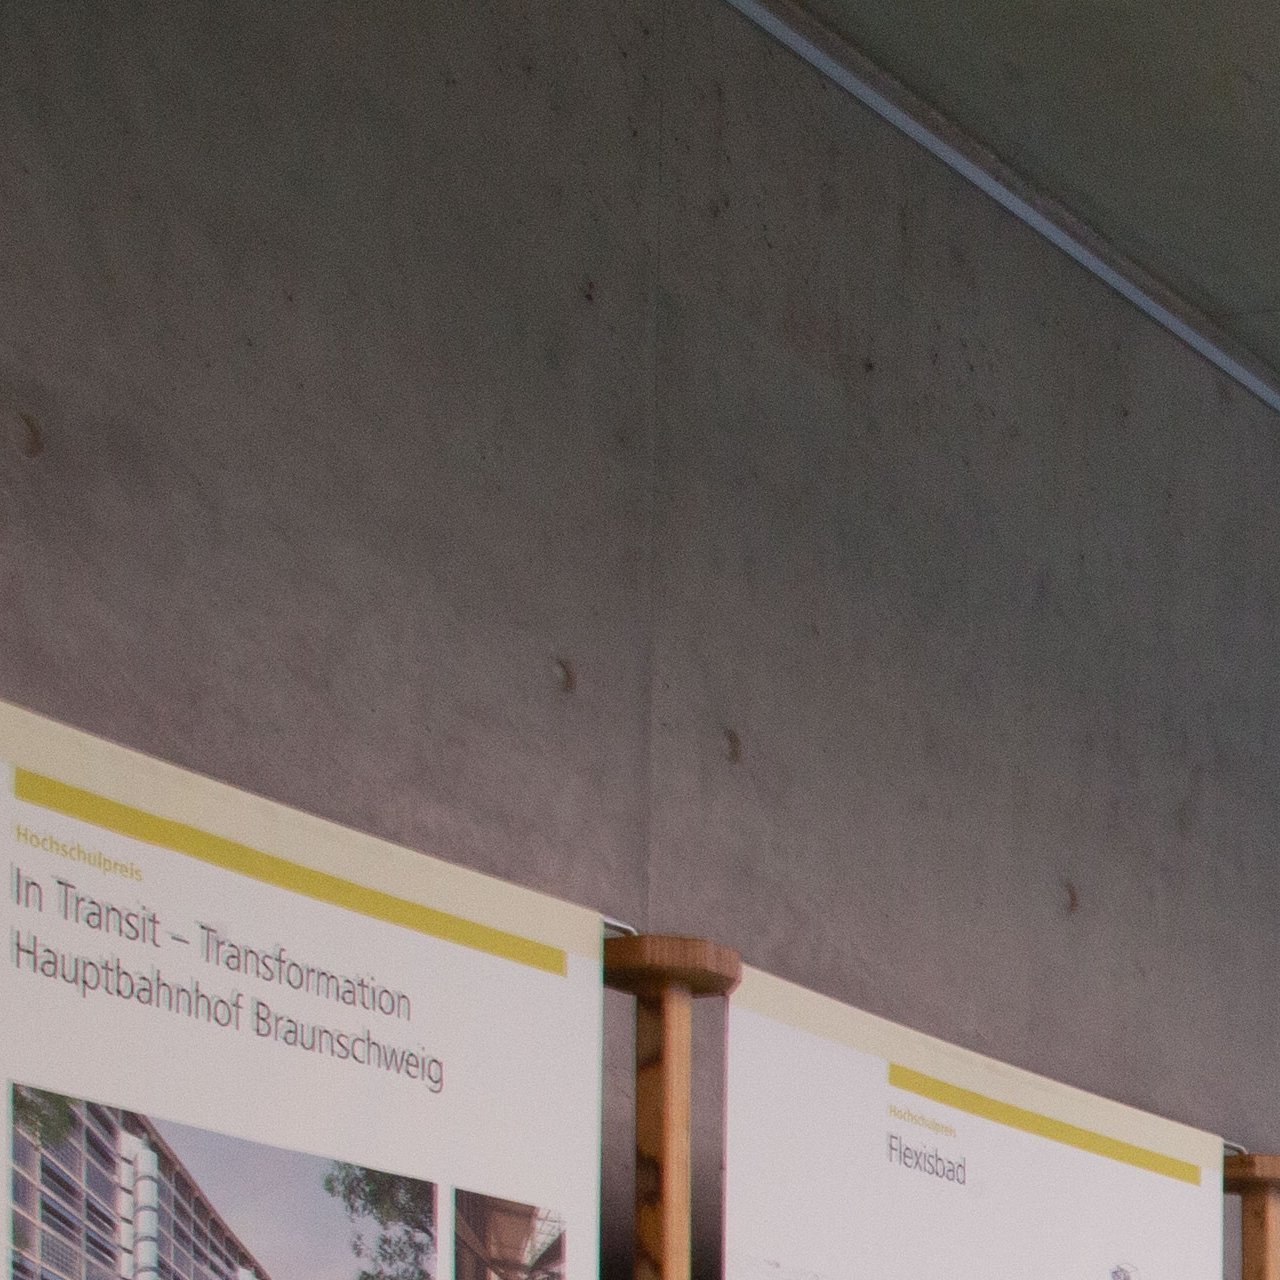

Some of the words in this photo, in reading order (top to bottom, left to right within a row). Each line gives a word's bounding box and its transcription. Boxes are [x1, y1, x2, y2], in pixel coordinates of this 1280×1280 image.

[14, 823, 143, 882] Hochschulpreis
[12, 866, 43, 912] In
[56, 877, 161, 949] Transit
[201, 921, 411, 1022] Transformation
[12, 929, 242, 1031] Hauptbahnhof
[255, 1000, 444, 1094] Braunschweig
[888, 1133, 967, 1185] Flexisbad
